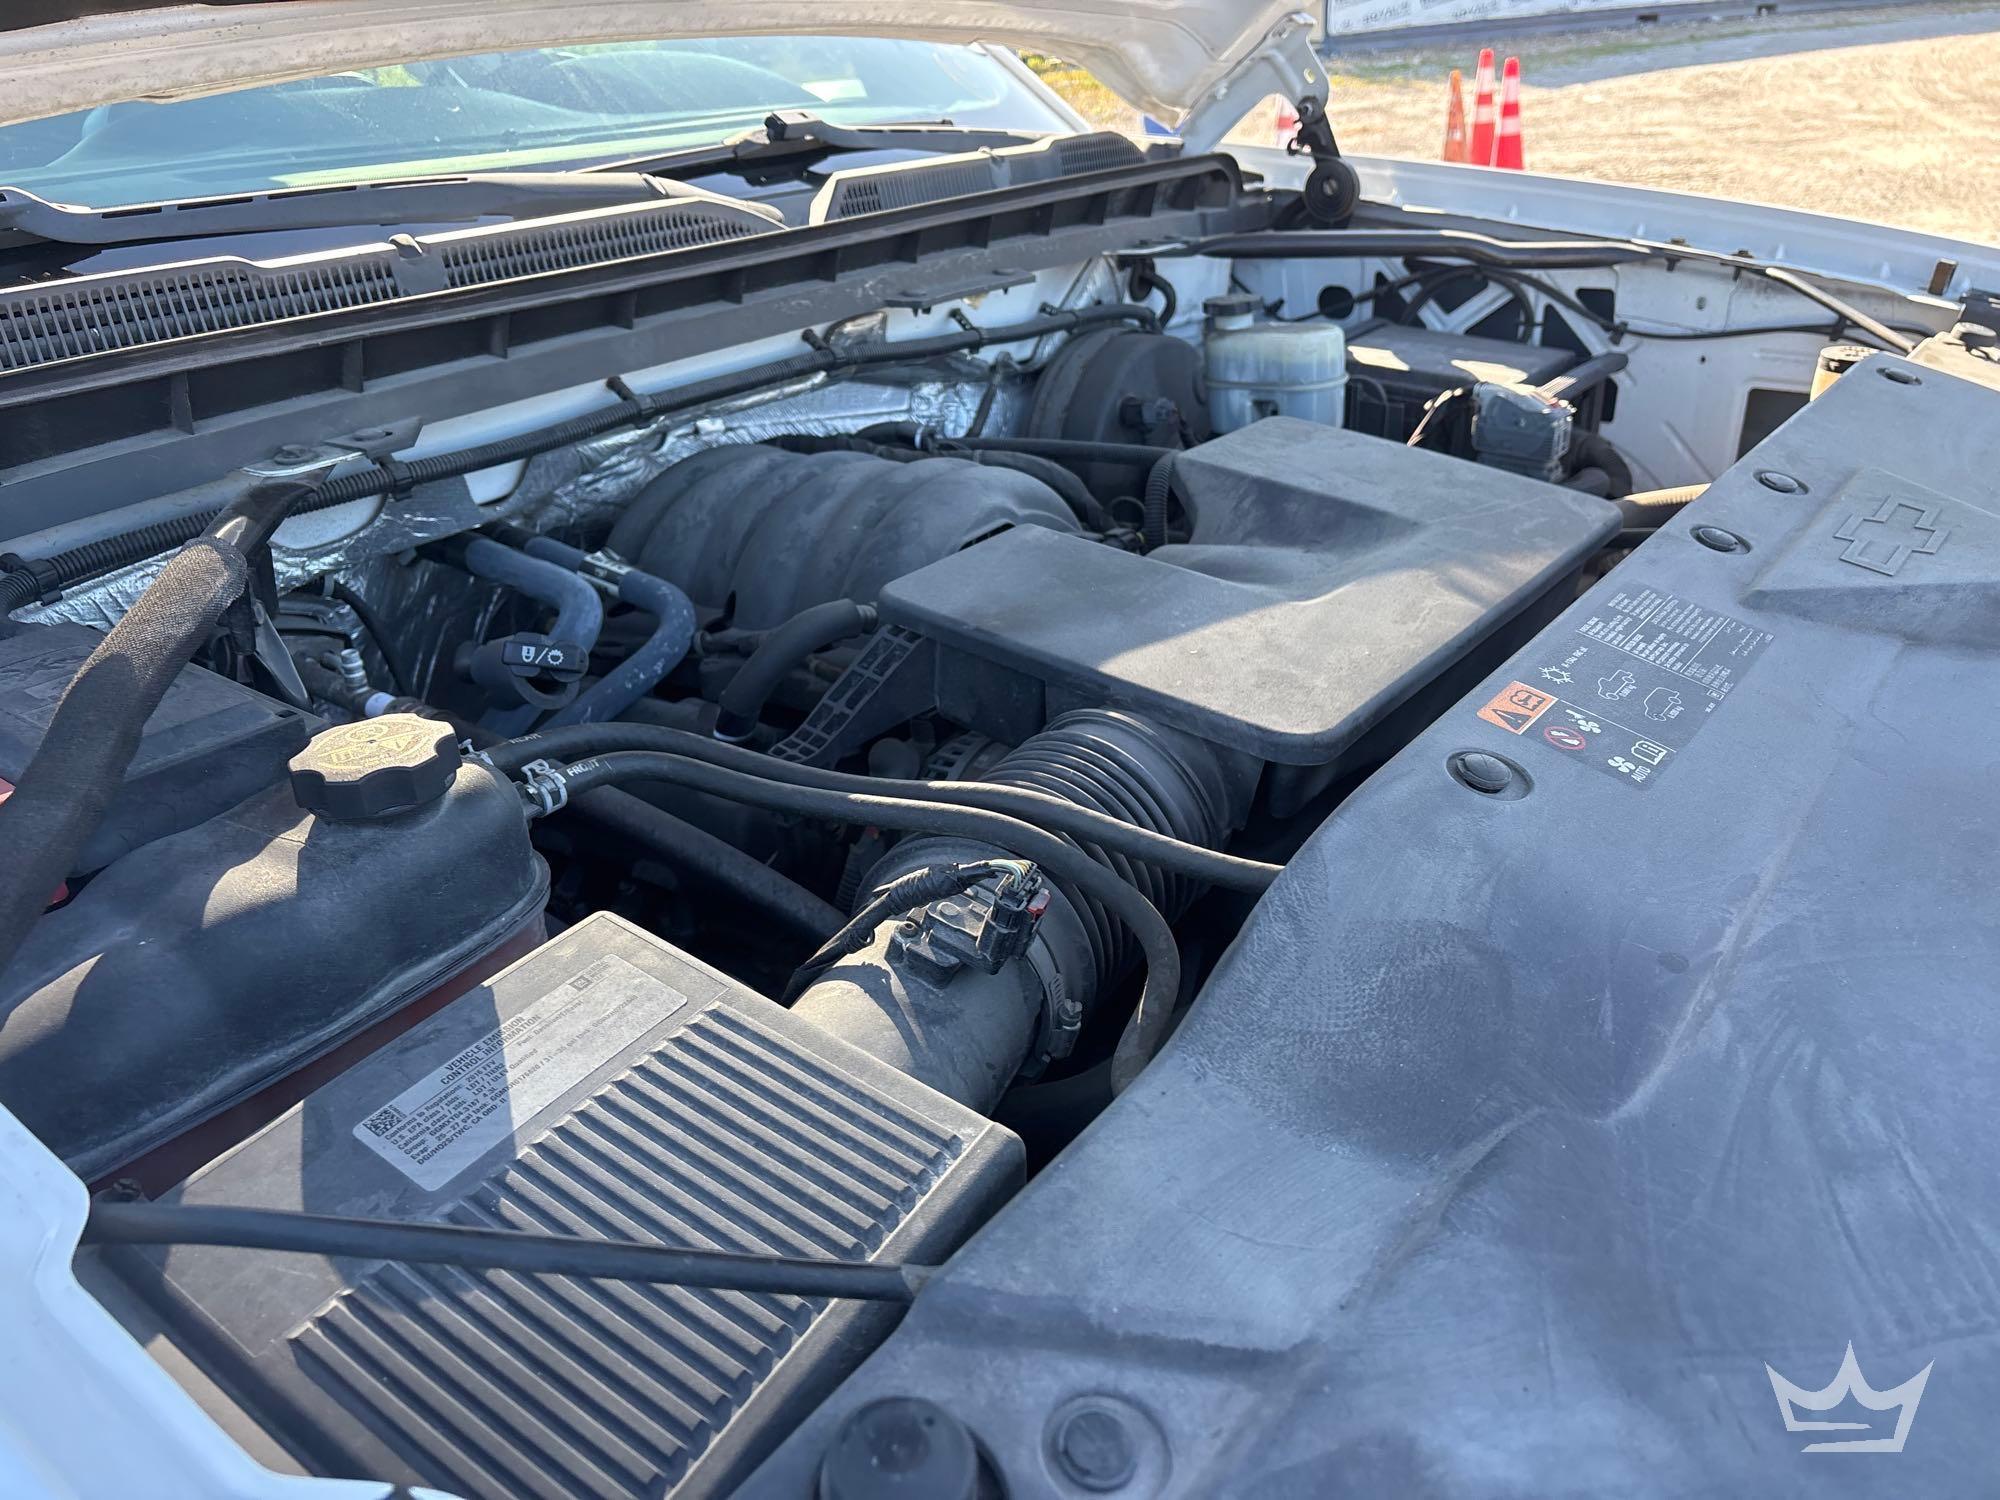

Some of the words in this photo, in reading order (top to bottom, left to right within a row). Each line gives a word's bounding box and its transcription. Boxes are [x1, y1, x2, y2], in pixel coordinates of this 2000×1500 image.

[1630, 765, 1651, 783] AUTO
[440, 1054, 484, 1086] CONTROL
[482, 1014, 542, 1056] INFORMATION
[445, 1044, 484, 1072] VEHICLE
[482, 1016, 525, 1046] EMISSION
[384, 1116, 417, 1140] Conforms
[465, 1070, 483, 1082] 2016
[390, 1133, 407, 1145] U.S.
[407, 1122, 423, 1133] EPA
[422, 1109, 441, 1123] class
[466, 1080, 481, 1091] LDT
[397, 1125, 431, 1150] California
[429, 1113, 448, 1127] class
[472, 1085, 487, 1096] LDT
[491, 1069, 509, 1082] ULEV
[404, 1137, 429, 1156] Group:
[481, 1086, 498, 1098] 4.3L
[470, 1115, 483, 1125] CA
[410, 1144, 432, 1160] Evap:
